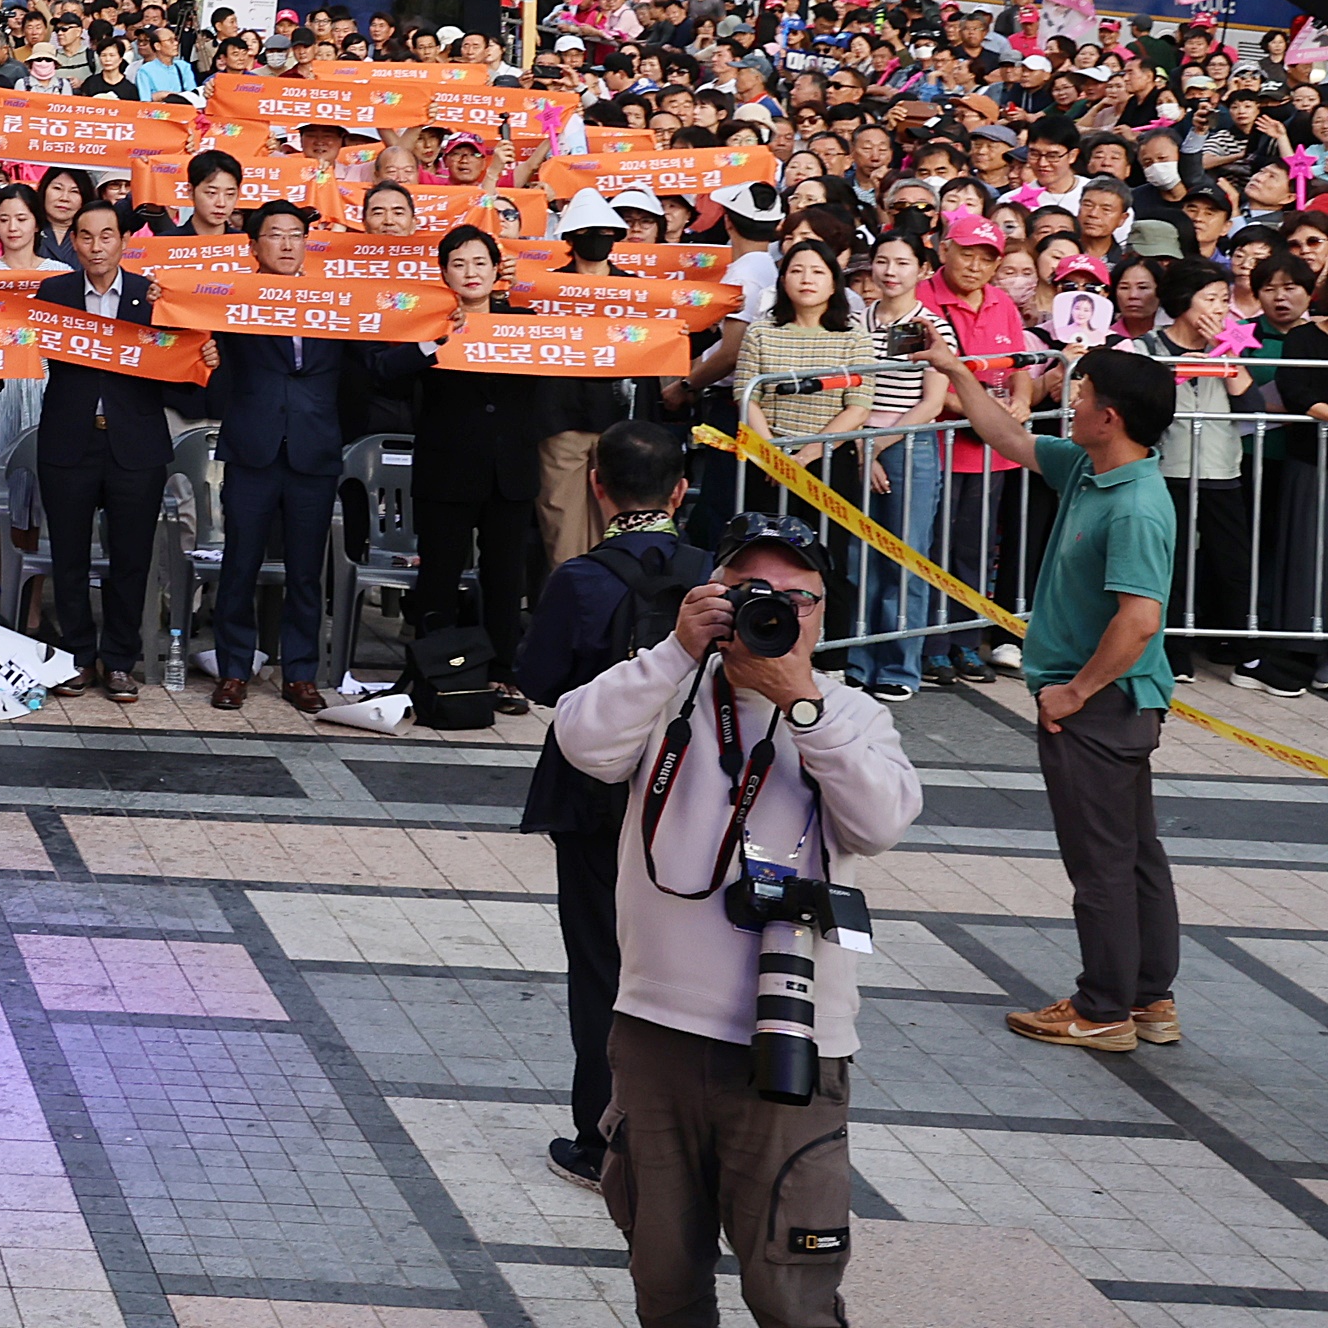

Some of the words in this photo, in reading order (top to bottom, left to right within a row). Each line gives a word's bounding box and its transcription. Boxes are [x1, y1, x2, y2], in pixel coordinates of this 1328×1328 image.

[620, 160, 647, 170] 2024
[650, 158, 681, 169] 진도의
[684, 156, 695, 168] 날
[596, 174, 653, 191] 진도로
[659, 173, 697, 188] 오는
[701, 170, 722, 186] 길
[258, 287, 291, 301] 2024
[296, 290, 334, 304] 진도의
[339, 291, 352, 306] 날
[225, 304, 296, 327] 진도로
[303, 307, 350, 330] 오는
[358, 311, 381, 332] 길
[493, 325, 525, 337] 2024
[529, 326, 567, 339] 진도의
[572, 326, 583, 339] 날
[463, 343, 531, 364] 진도로
[539, 344, 585, 365] 오는
[592, 345, 616, 366] 길
[750, 588, 772, 596] Canon
[719, 705, 733, 744] Canon
[653, 751, 678, 796] Canon
[741, 775, 761, 807] EOS
